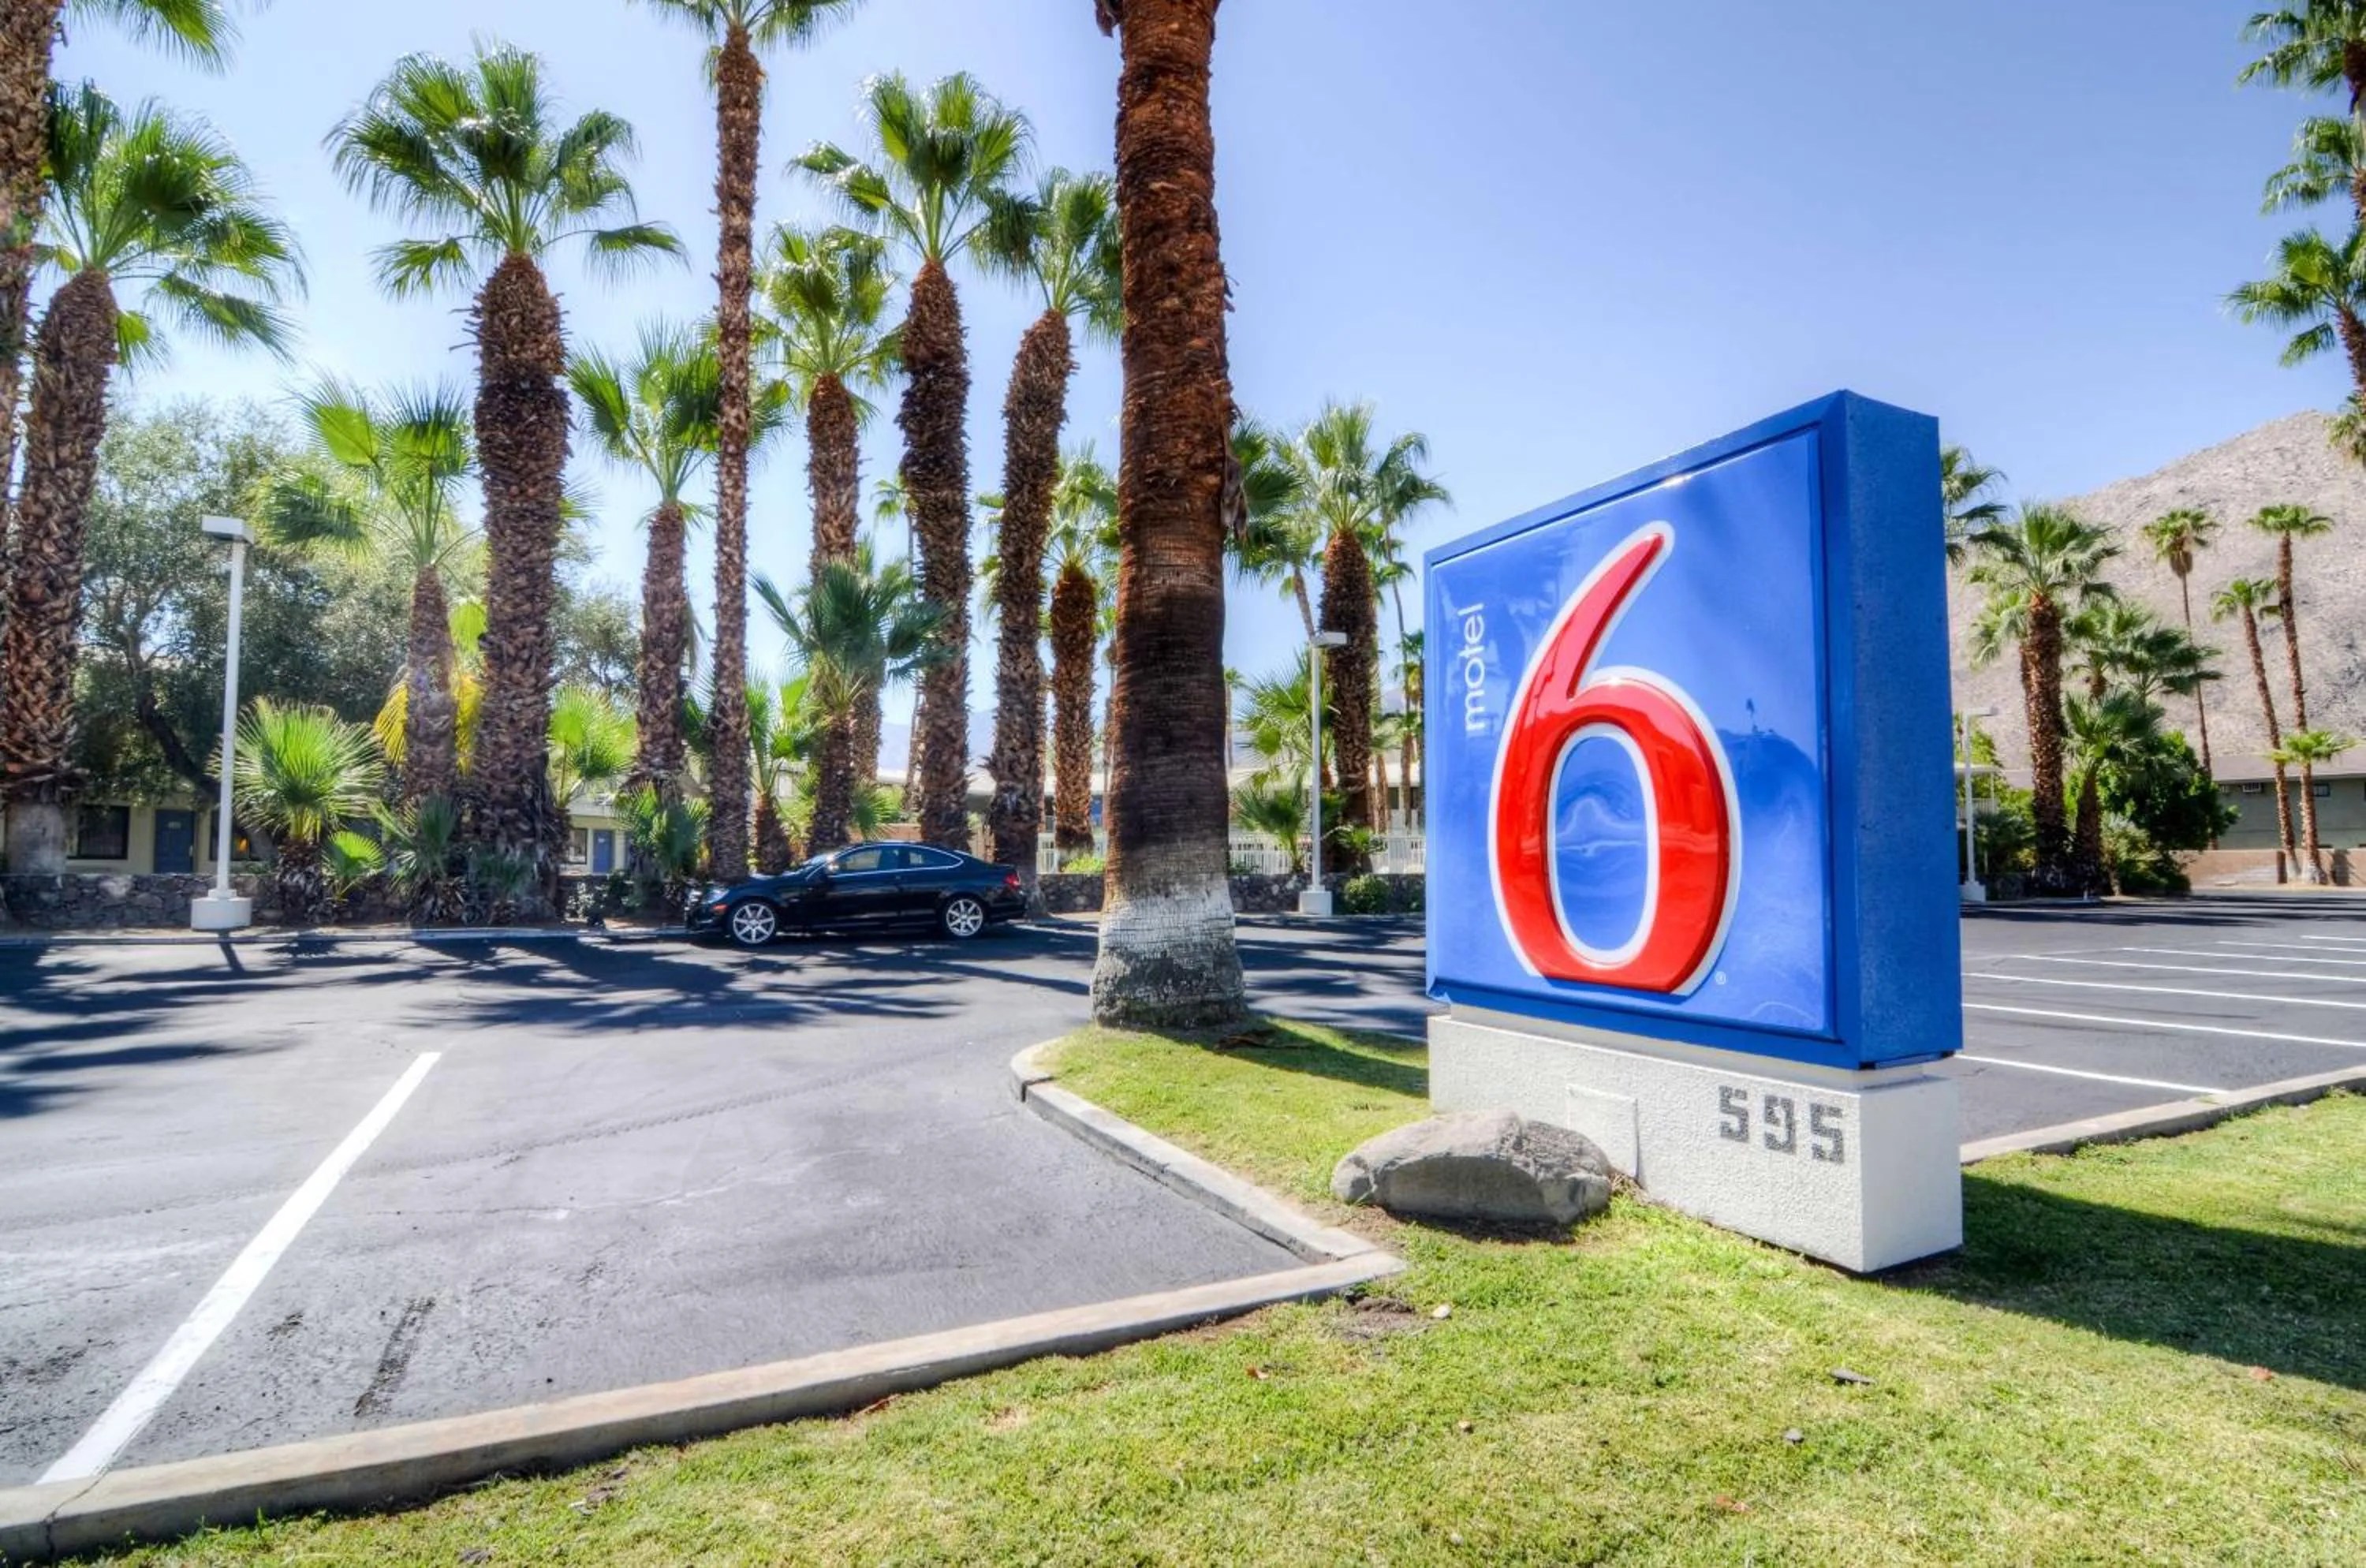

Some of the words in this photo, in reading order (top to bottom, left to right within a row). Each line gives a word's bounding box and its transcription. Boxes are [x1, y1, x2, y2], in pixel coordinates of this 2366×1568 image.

[1457, 603, 1486, 732] motel
[1488, 521, 1741, 996] 6
[1718, 1085, 1845, 1164] 595
